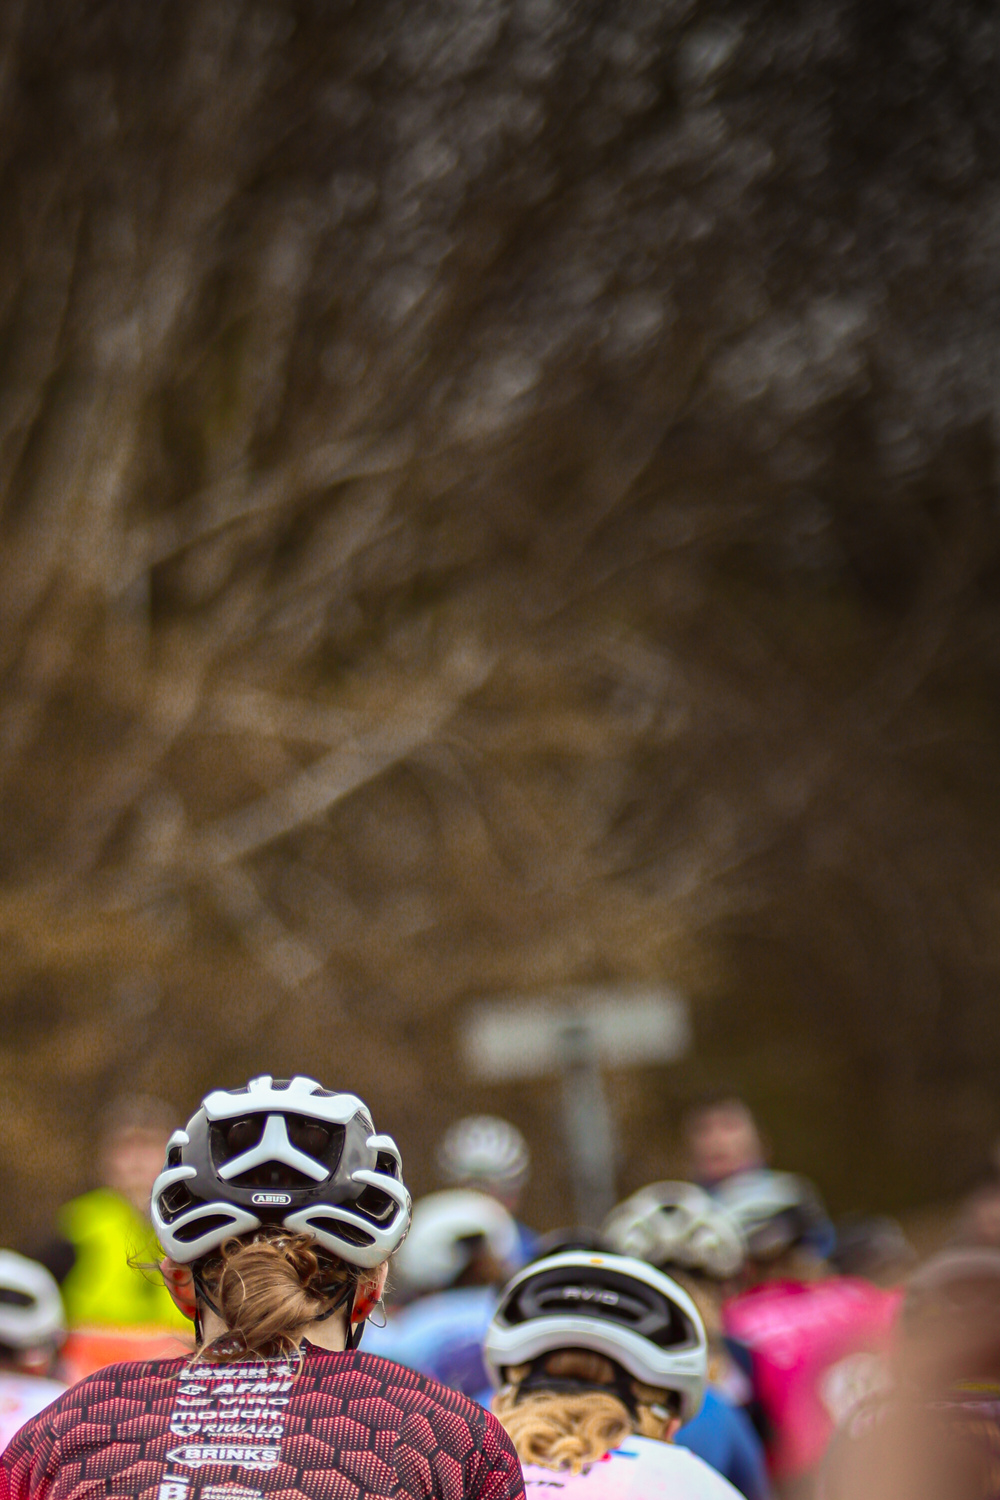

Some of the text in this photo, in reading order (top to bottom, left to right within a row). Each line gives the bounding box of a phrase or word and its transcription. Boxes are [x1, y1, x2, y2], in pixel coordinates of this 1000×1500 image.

[212, 1382, 293, 1394] AFMI
[202, 1423, 284, 1434] RIWALD
[185, 1449, 276, 1460] BRINKS
